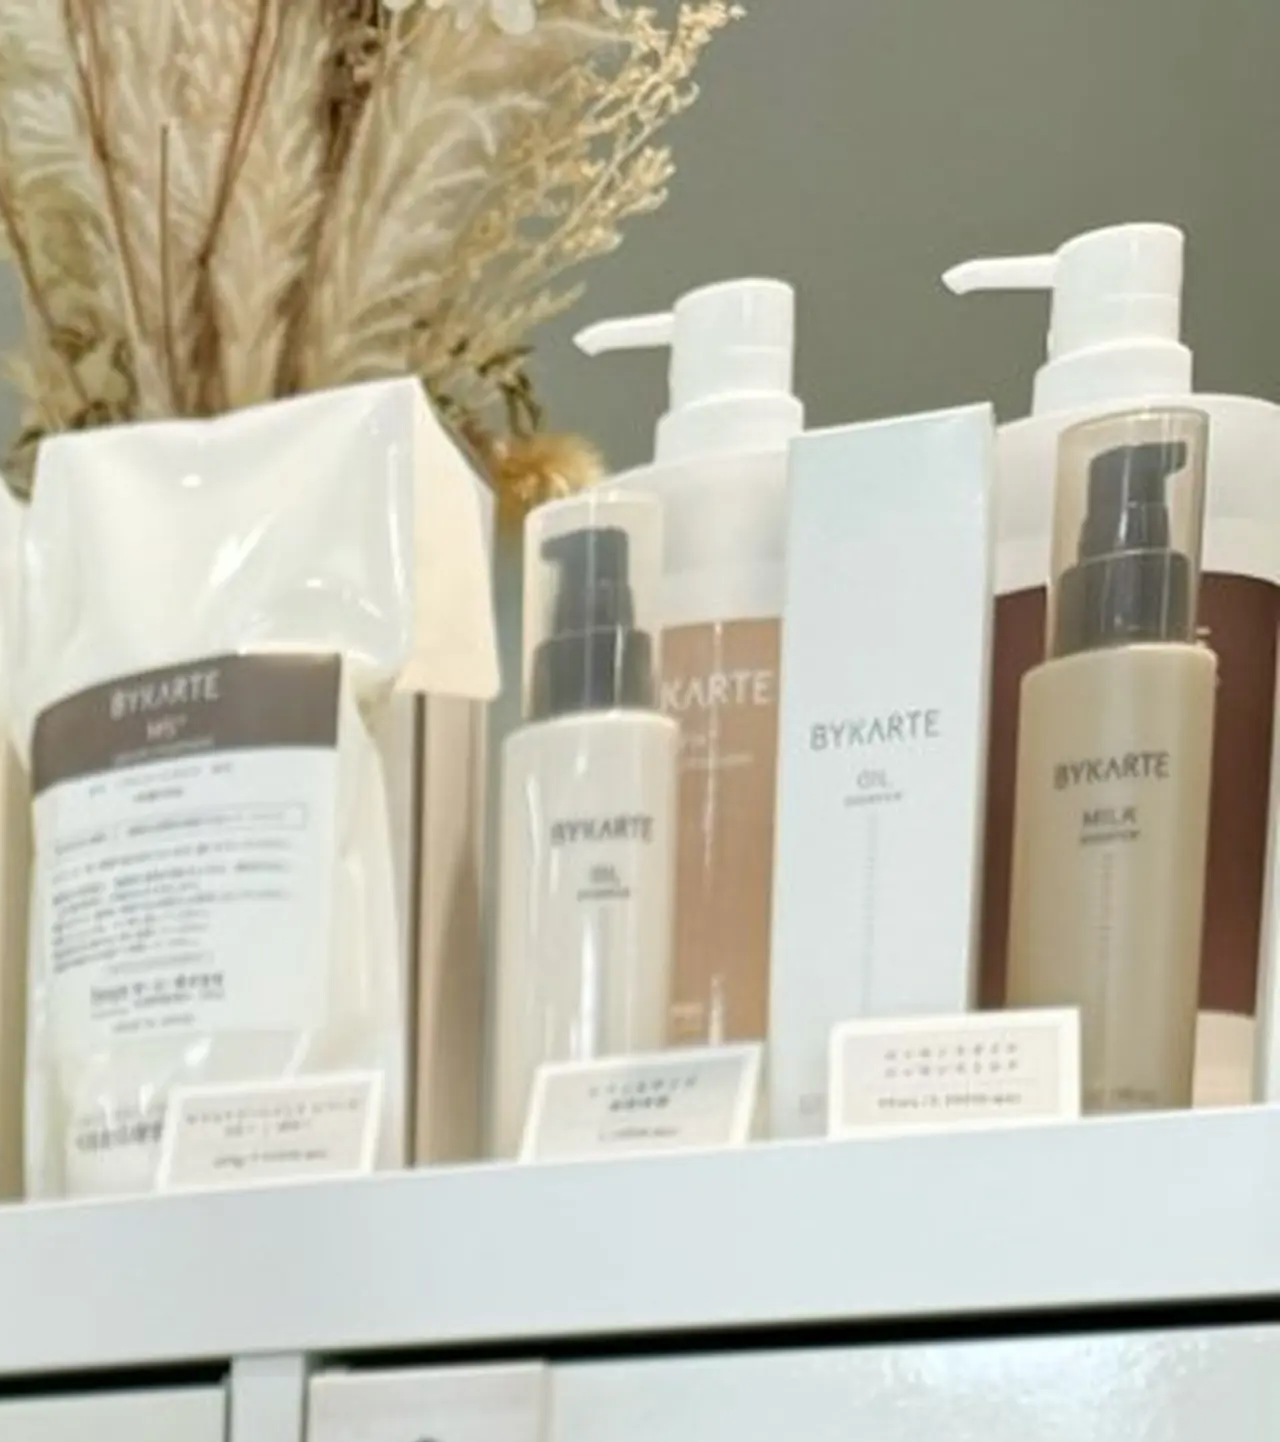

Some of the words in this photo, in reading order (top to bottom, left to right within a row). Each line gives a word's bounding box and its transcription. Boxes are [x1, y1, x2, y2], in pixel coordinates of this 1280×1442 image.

[660, 668, 775, 714] KARTE
[809, 708, 941, 751] BYKARTE
[1052, 750, 1170, 790] BYKARTE
